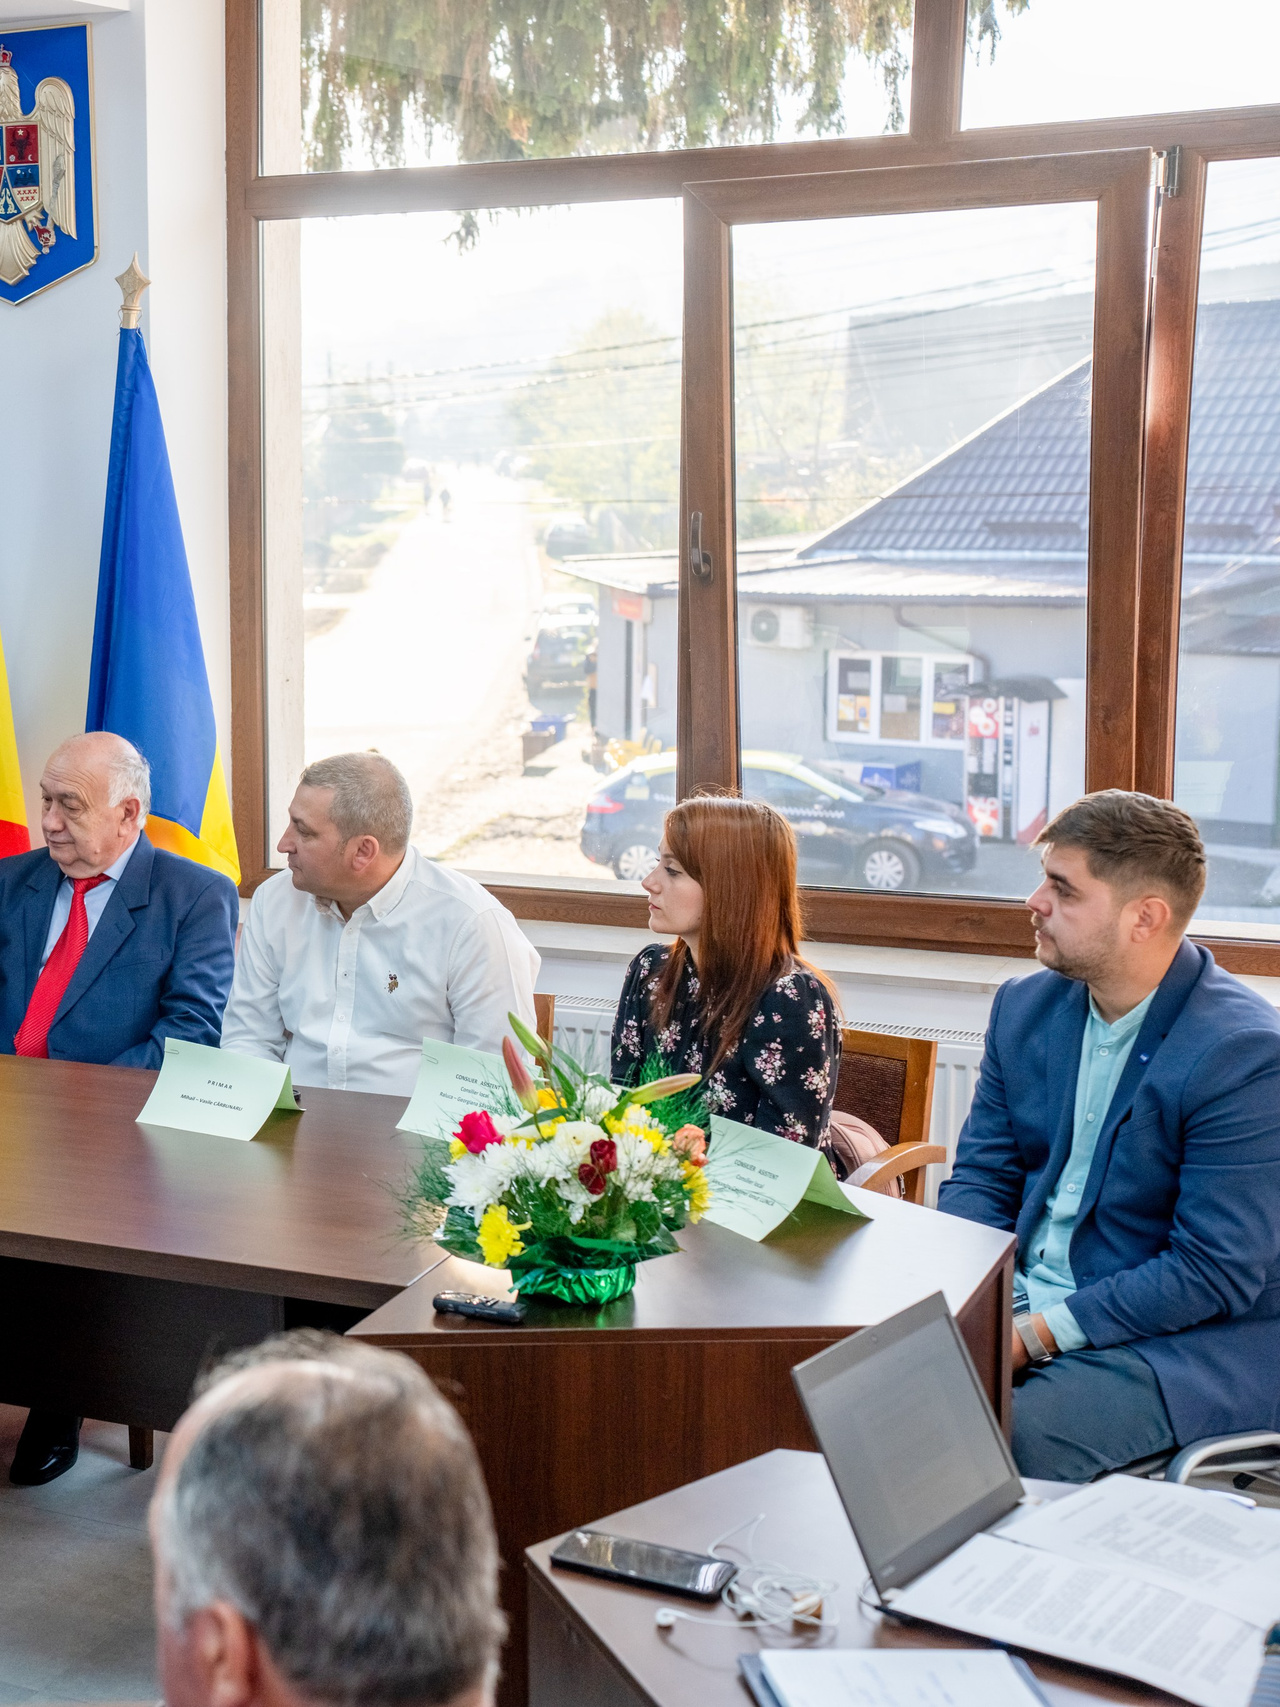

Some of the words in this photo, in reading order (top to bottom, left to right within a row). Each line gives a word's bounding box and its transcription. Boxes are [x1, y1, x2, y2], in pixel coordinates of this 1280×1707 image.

[455, 1074, 478, 1084] CONSILIER
[460, 1086, 479, 1095] Consilier
[734, 1159, 756, 1171] CONSILIER
[758, 1169, 779, 1180] ASISTENT
